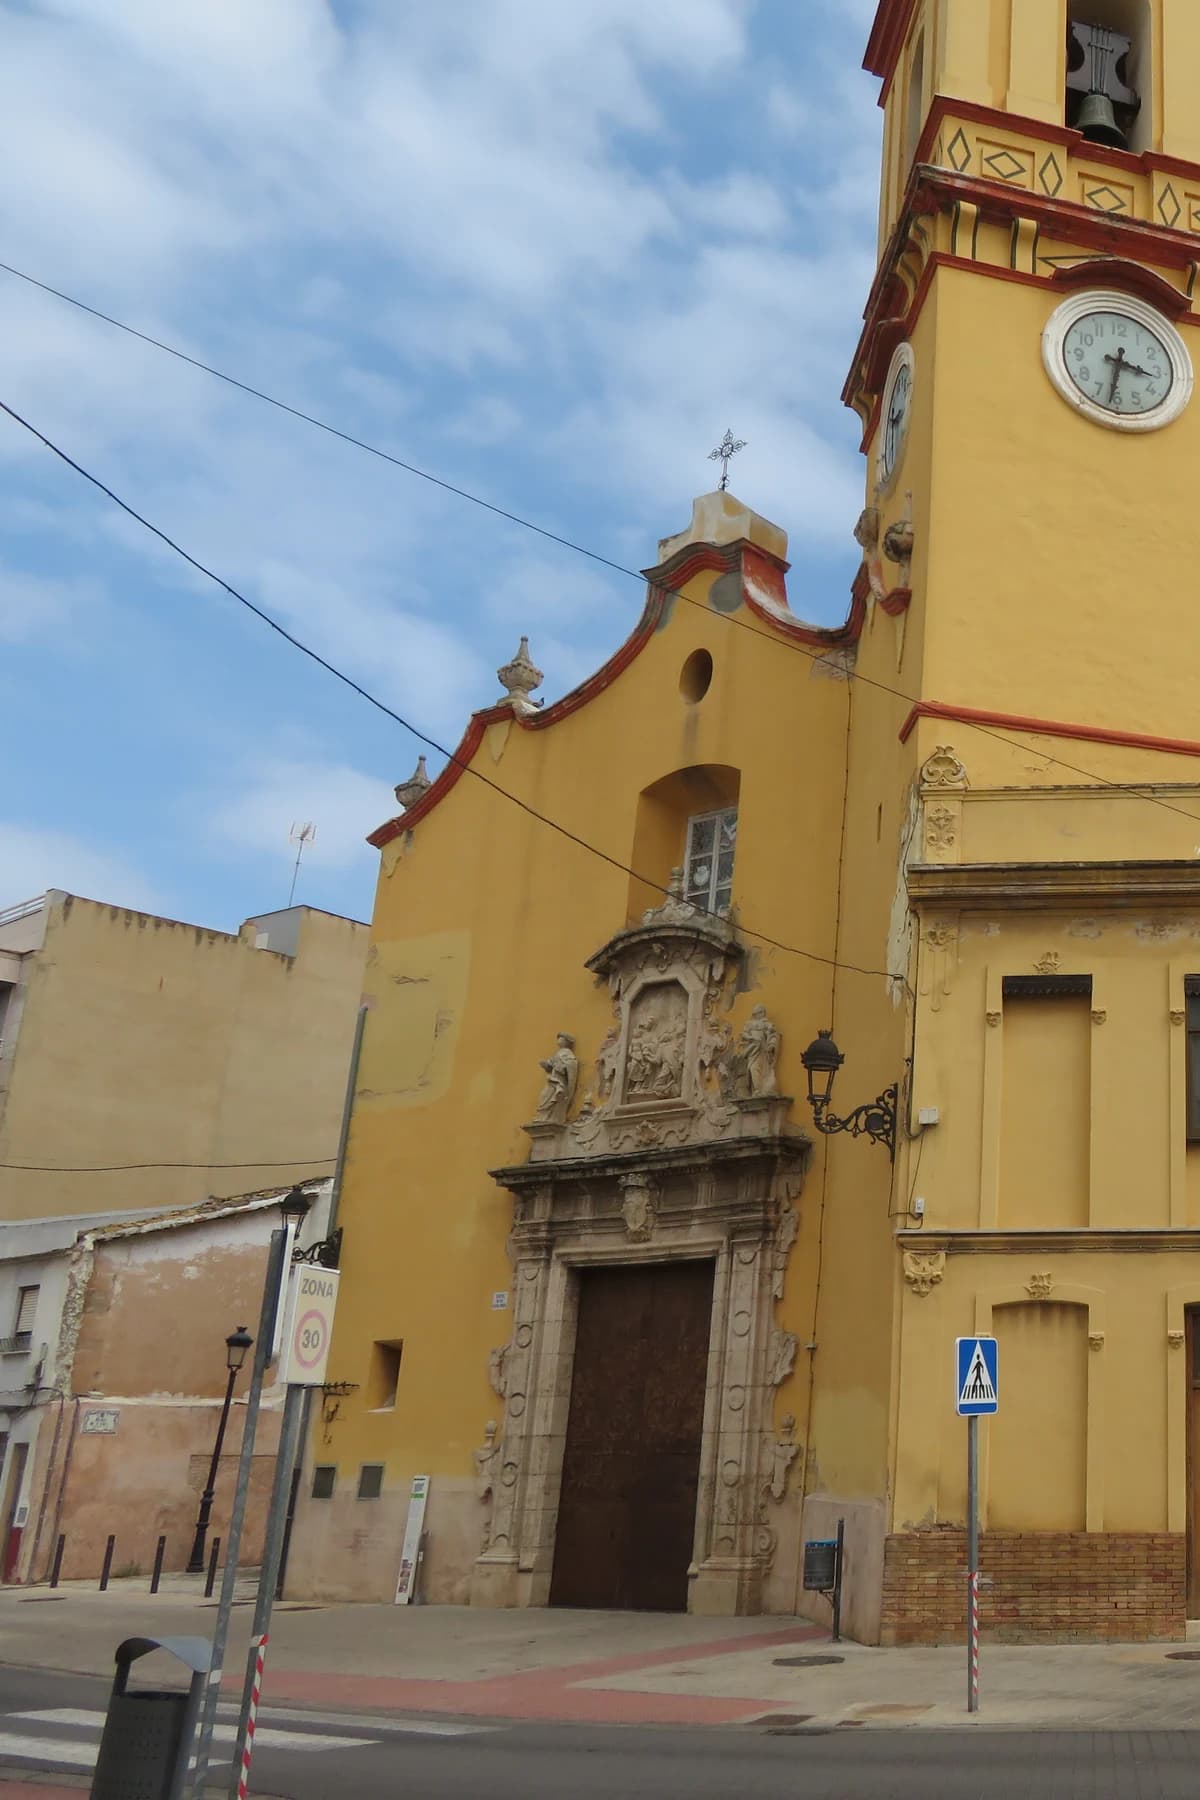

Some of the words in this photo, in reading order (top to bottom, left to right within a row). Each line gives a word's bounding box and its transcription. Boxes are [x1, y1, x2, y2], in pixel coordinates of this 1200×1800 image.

[1095, 321, 1104, 338] 11
[1112, 322, 1127, 338] 12
[1079, 332, 1094, 347] 10
[1073, 347, 1085, 361] 9
[1146, 346, 1156, 360] 2
[1079, 366, 1090, 381] 8
[1152, 364, 1162, 379] 3
[1094, 381, 1104, 396] 7
[1145, 381, 1157, 395] 4
[1113, 391, 1122, 405] 6
[1131, 391, 1141, 405] 5
[301, 1278, 333, 1297] ZONA
[302, 1330, 320, 1348] 30
